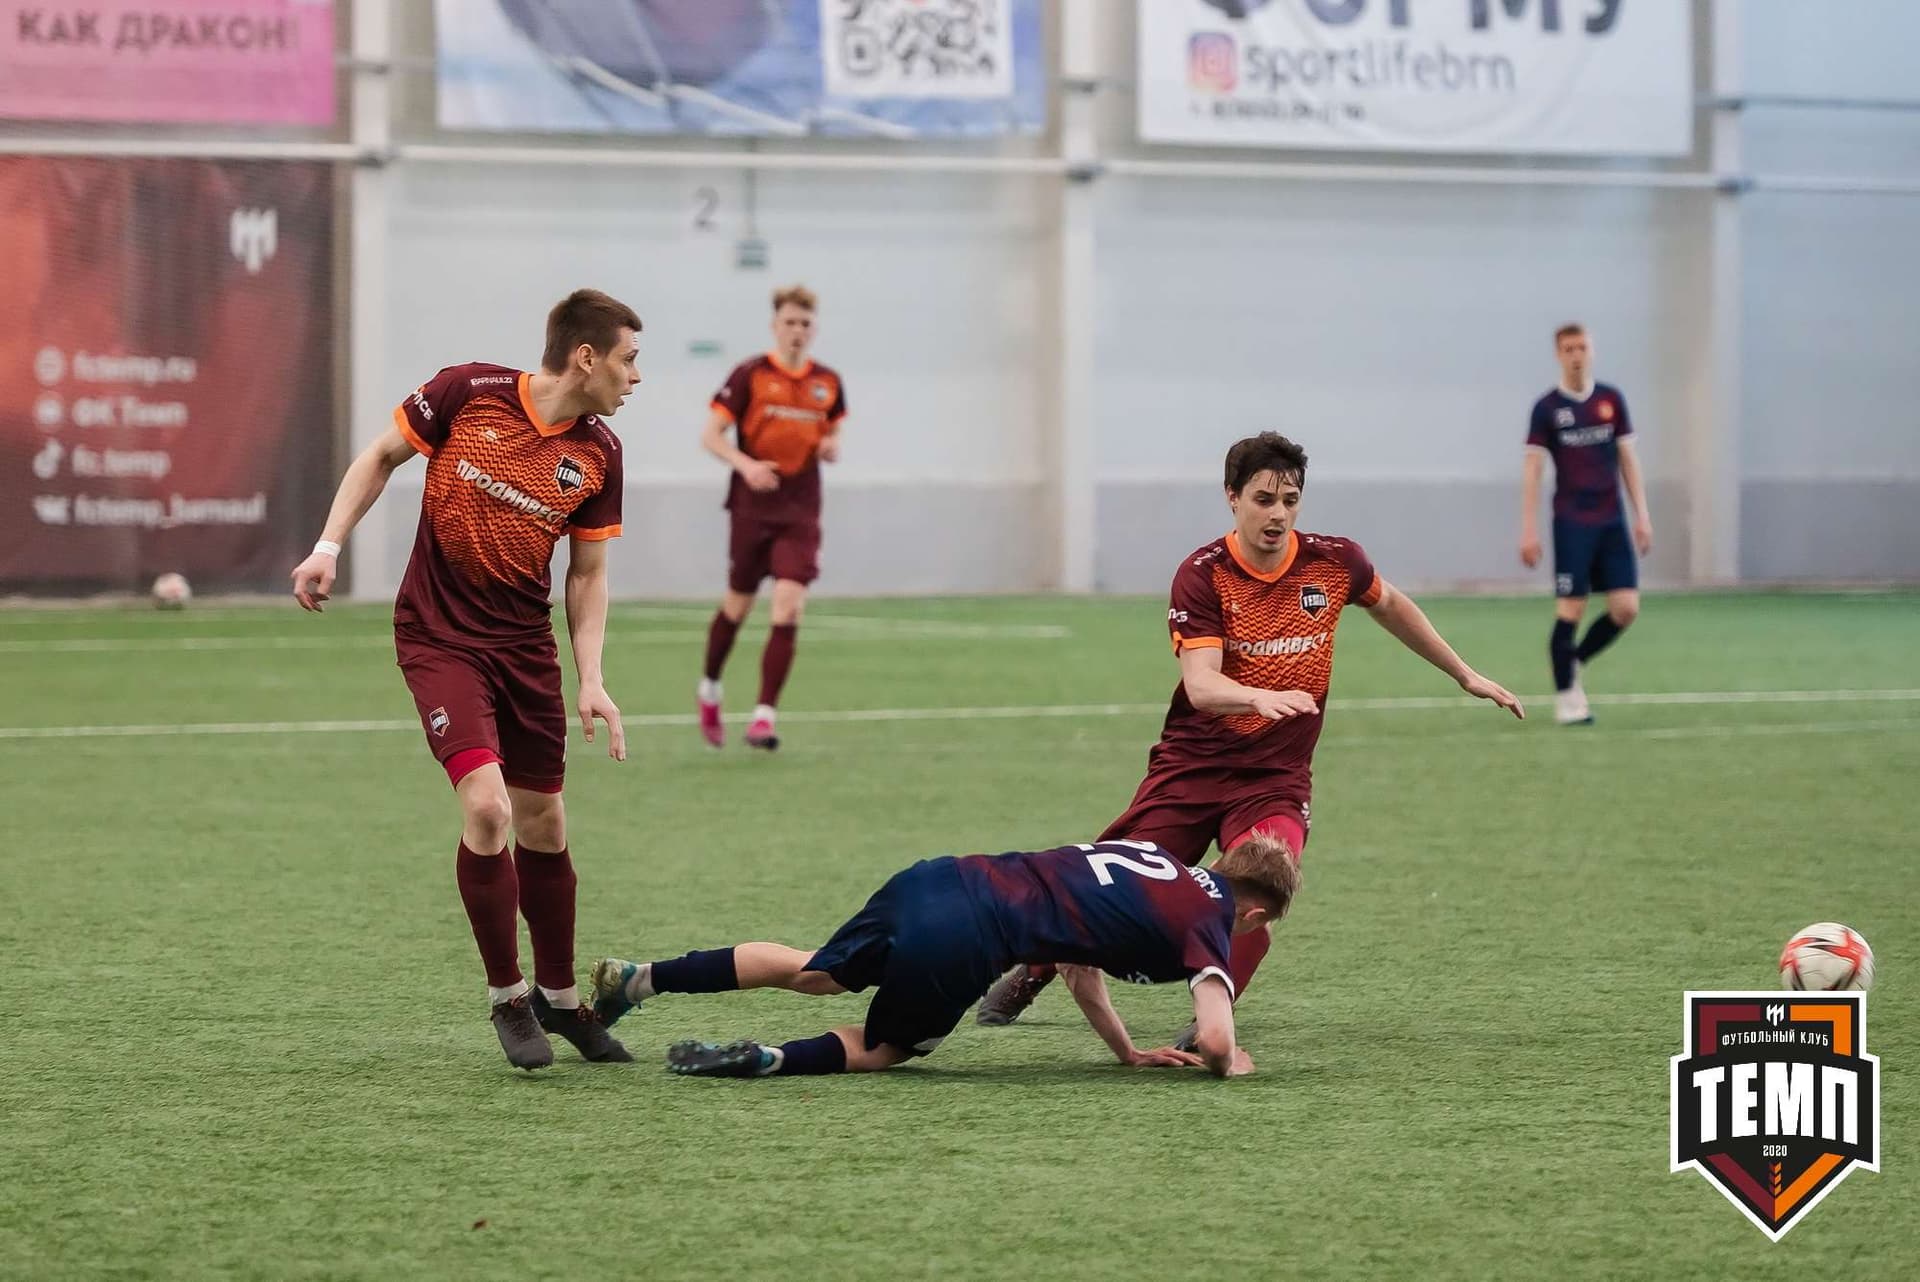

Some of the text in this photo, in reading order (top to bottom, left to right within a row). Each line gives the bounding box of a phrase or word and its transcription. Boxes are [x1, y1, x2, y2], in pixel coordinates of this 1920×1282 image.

[17, 10, 99, 43] КАК
[1246, 39, 1515, 91] sportlifebrn
[696, 187, 719, 232] 2
[557, 466, 582, 487] ТЕМП
